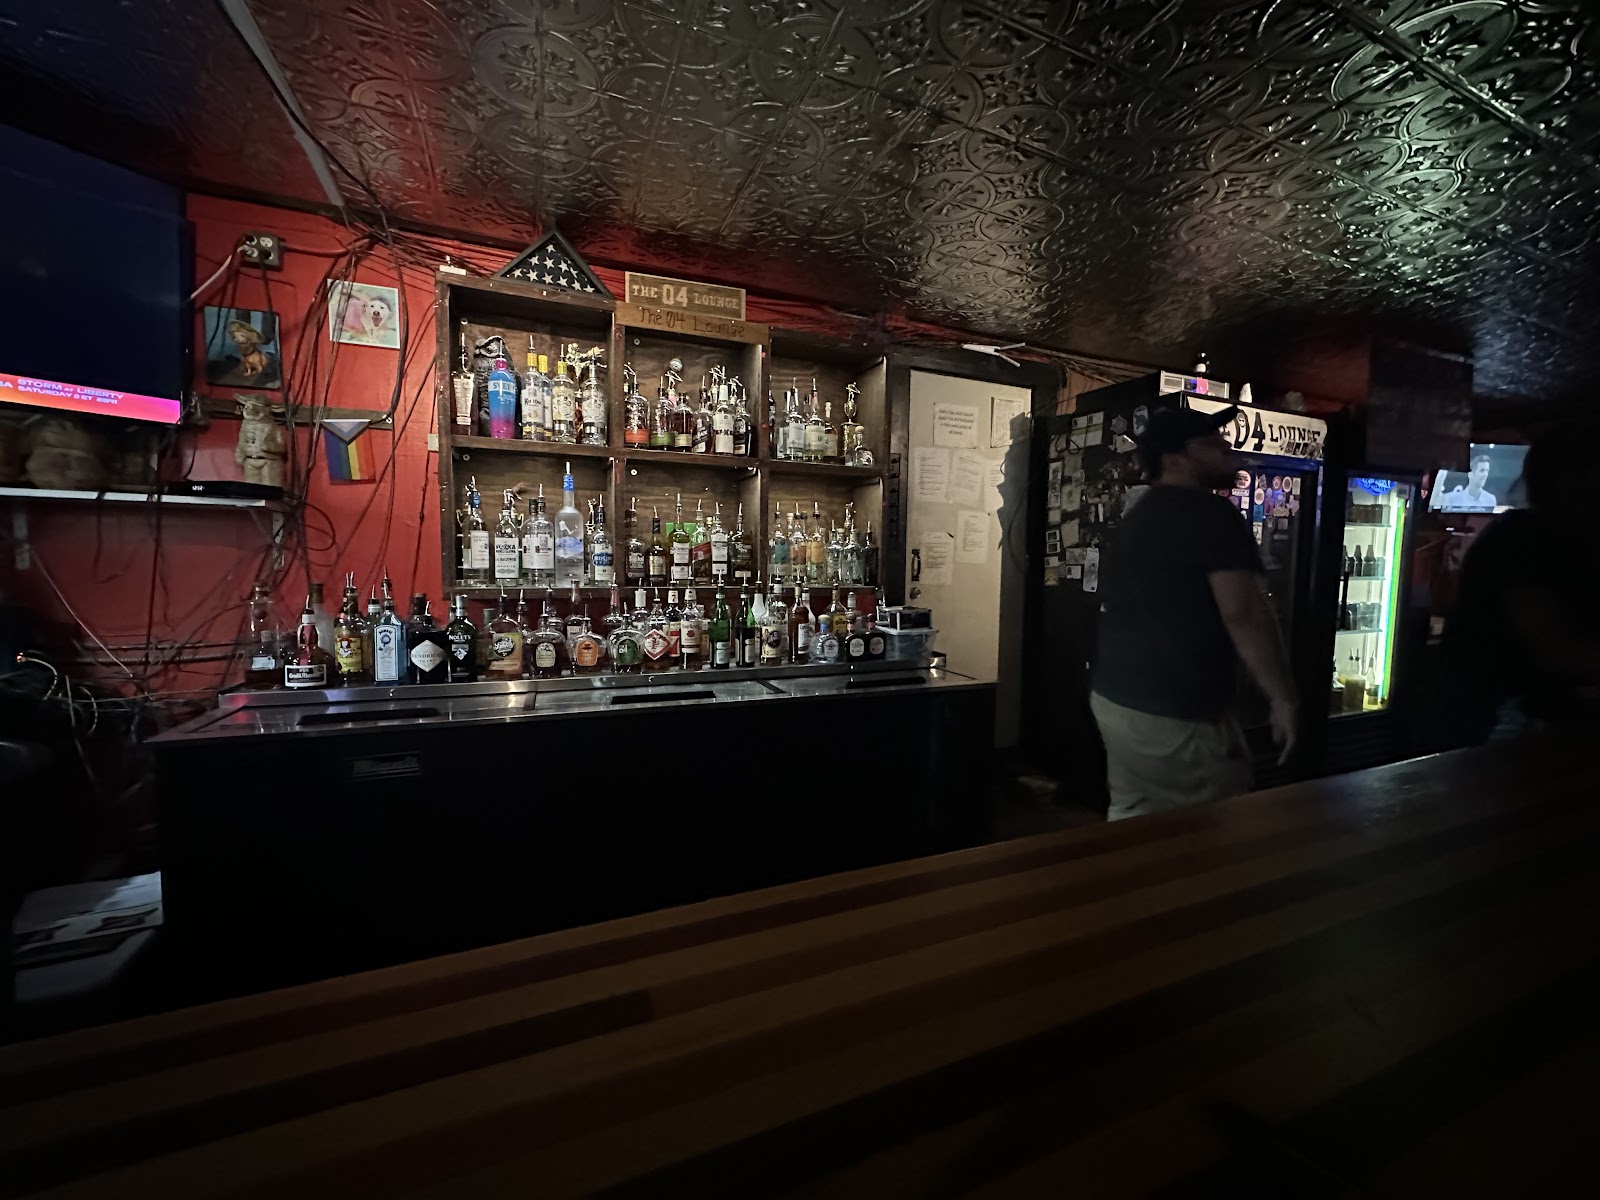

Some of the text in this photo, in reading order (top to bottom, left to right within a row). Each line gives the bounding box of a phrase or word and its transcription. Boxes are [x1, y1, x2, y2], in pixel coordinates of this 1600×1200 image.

[631, 284, 740, 310] THE 04 LOUNGE
[638, 307, 745, 338] The 04 Lounge
[17, 378, 62, 391] STORM
[77, 387, 124, 400] LIBERTY
[17, 385, 72, 398] SATURDAY
[1267, 424, 1321, 443] LOUNGE
